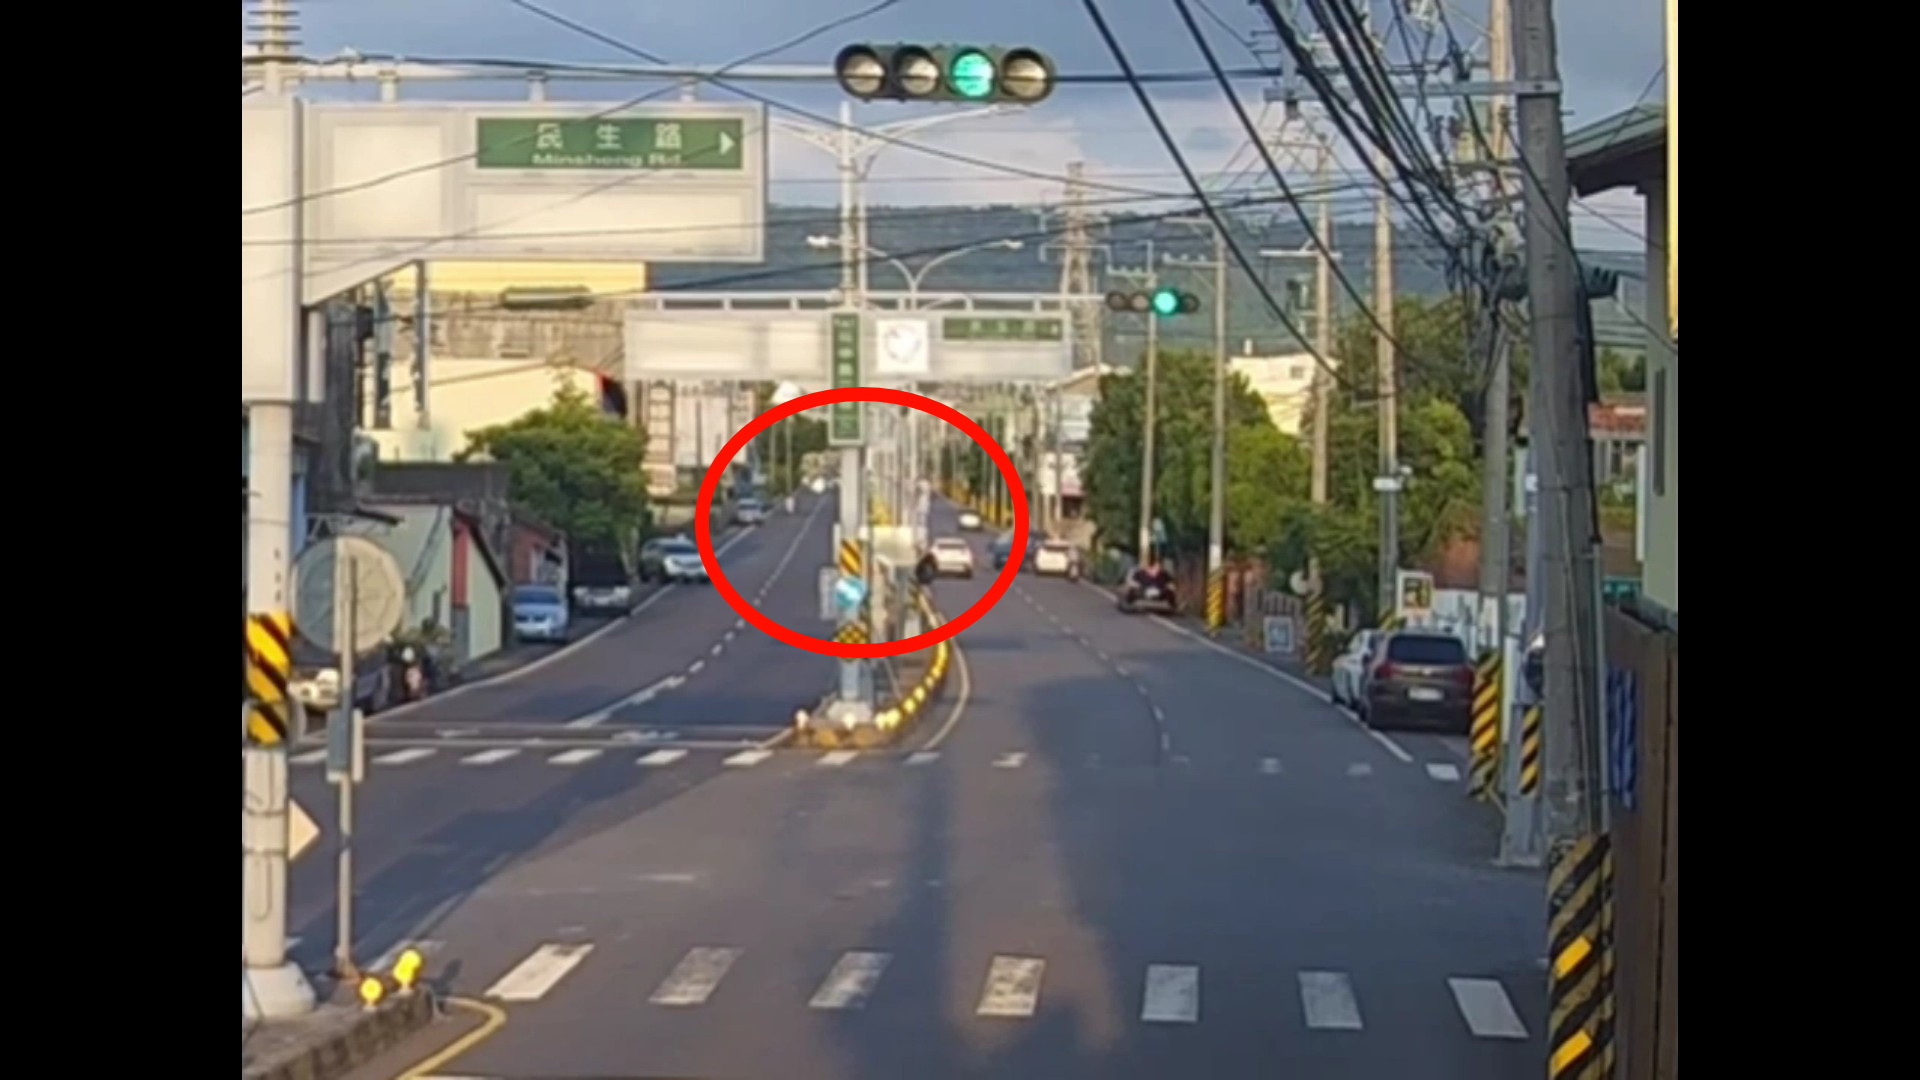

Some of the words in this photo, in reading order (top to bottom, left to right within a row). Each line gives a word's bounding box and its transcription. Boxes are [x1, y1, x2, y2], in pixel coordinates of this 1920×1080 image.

[536, 123, 682, 149] 民生路
[532, 153, 642, 166] Minsheng
